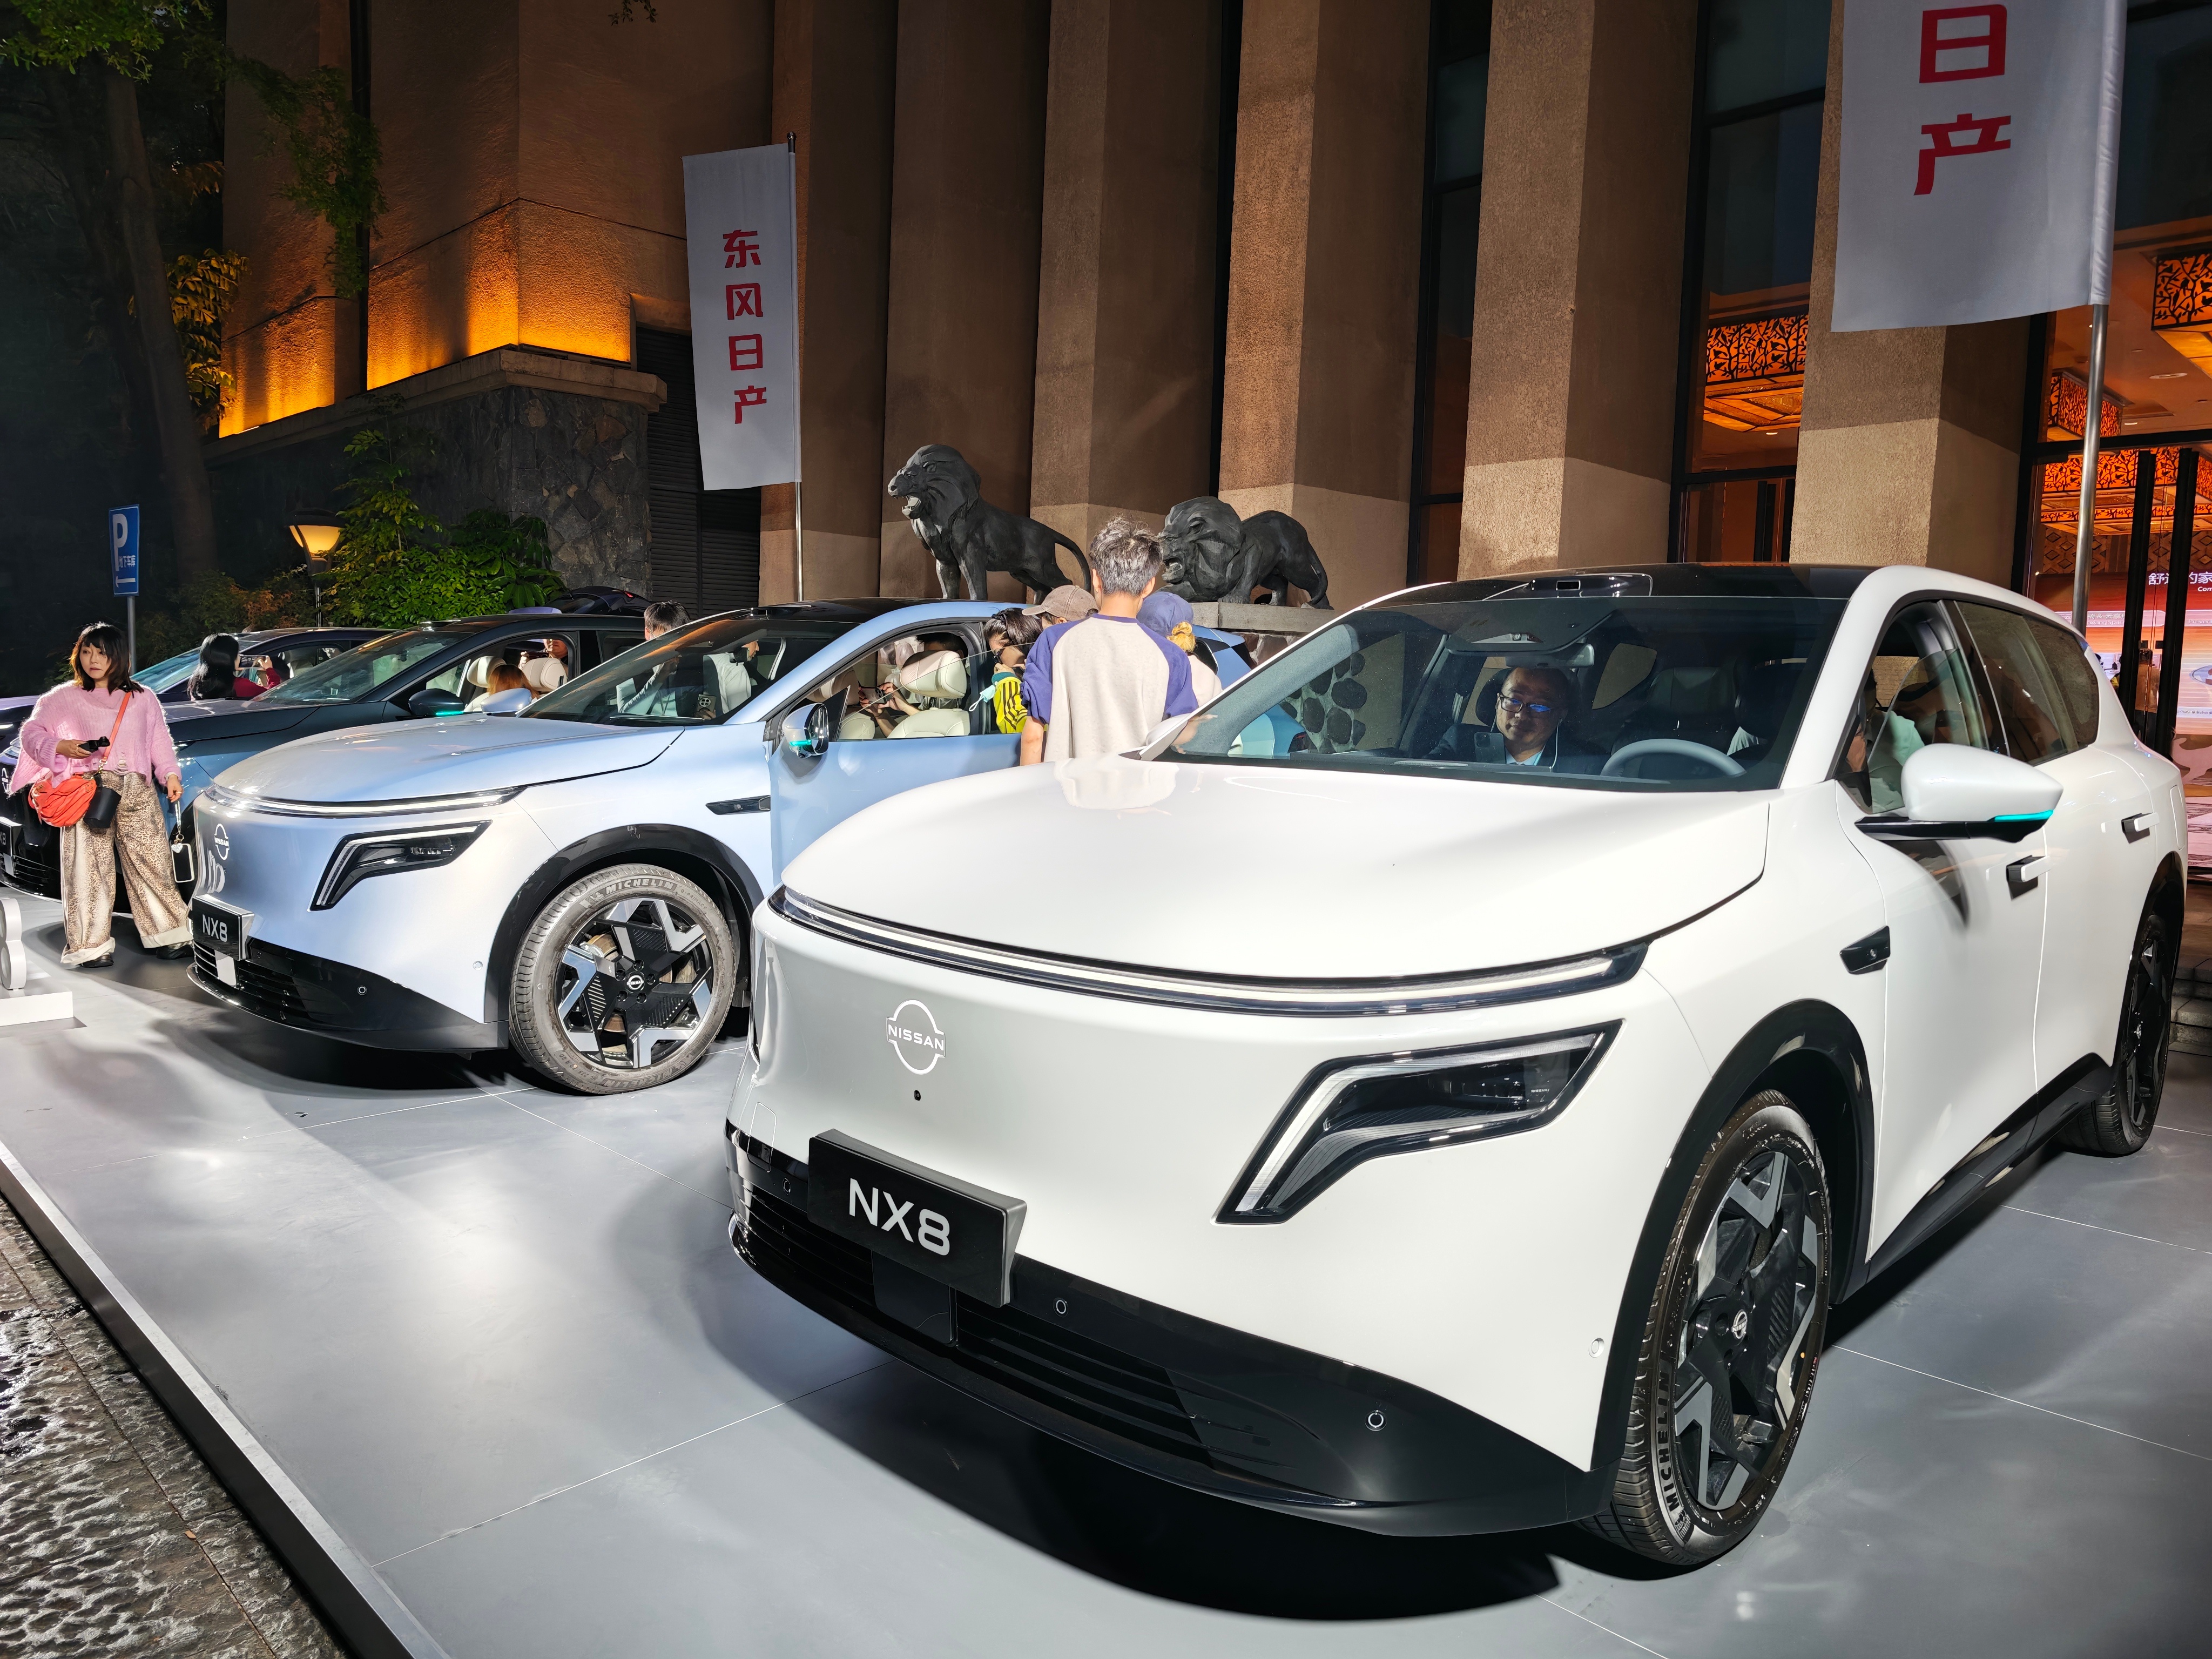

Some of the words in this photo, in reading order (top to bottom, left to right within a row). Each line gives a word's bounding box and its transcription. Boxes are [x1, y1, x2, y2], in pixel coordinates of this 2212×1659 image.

[1913, 3, 2011, 195] 日产
[723, 230, 767, 424] 东风日产
[112, 514, 128, 571] P
[605, 878, 675, 895] MICHELIN
[203, 914, 227, 942] NX8
[888, 1024, 944, 1051] NISSAN
[849, 1178, 950, 1256] NX8
[1657, 1371, 1680, 1512] MICHELIN
